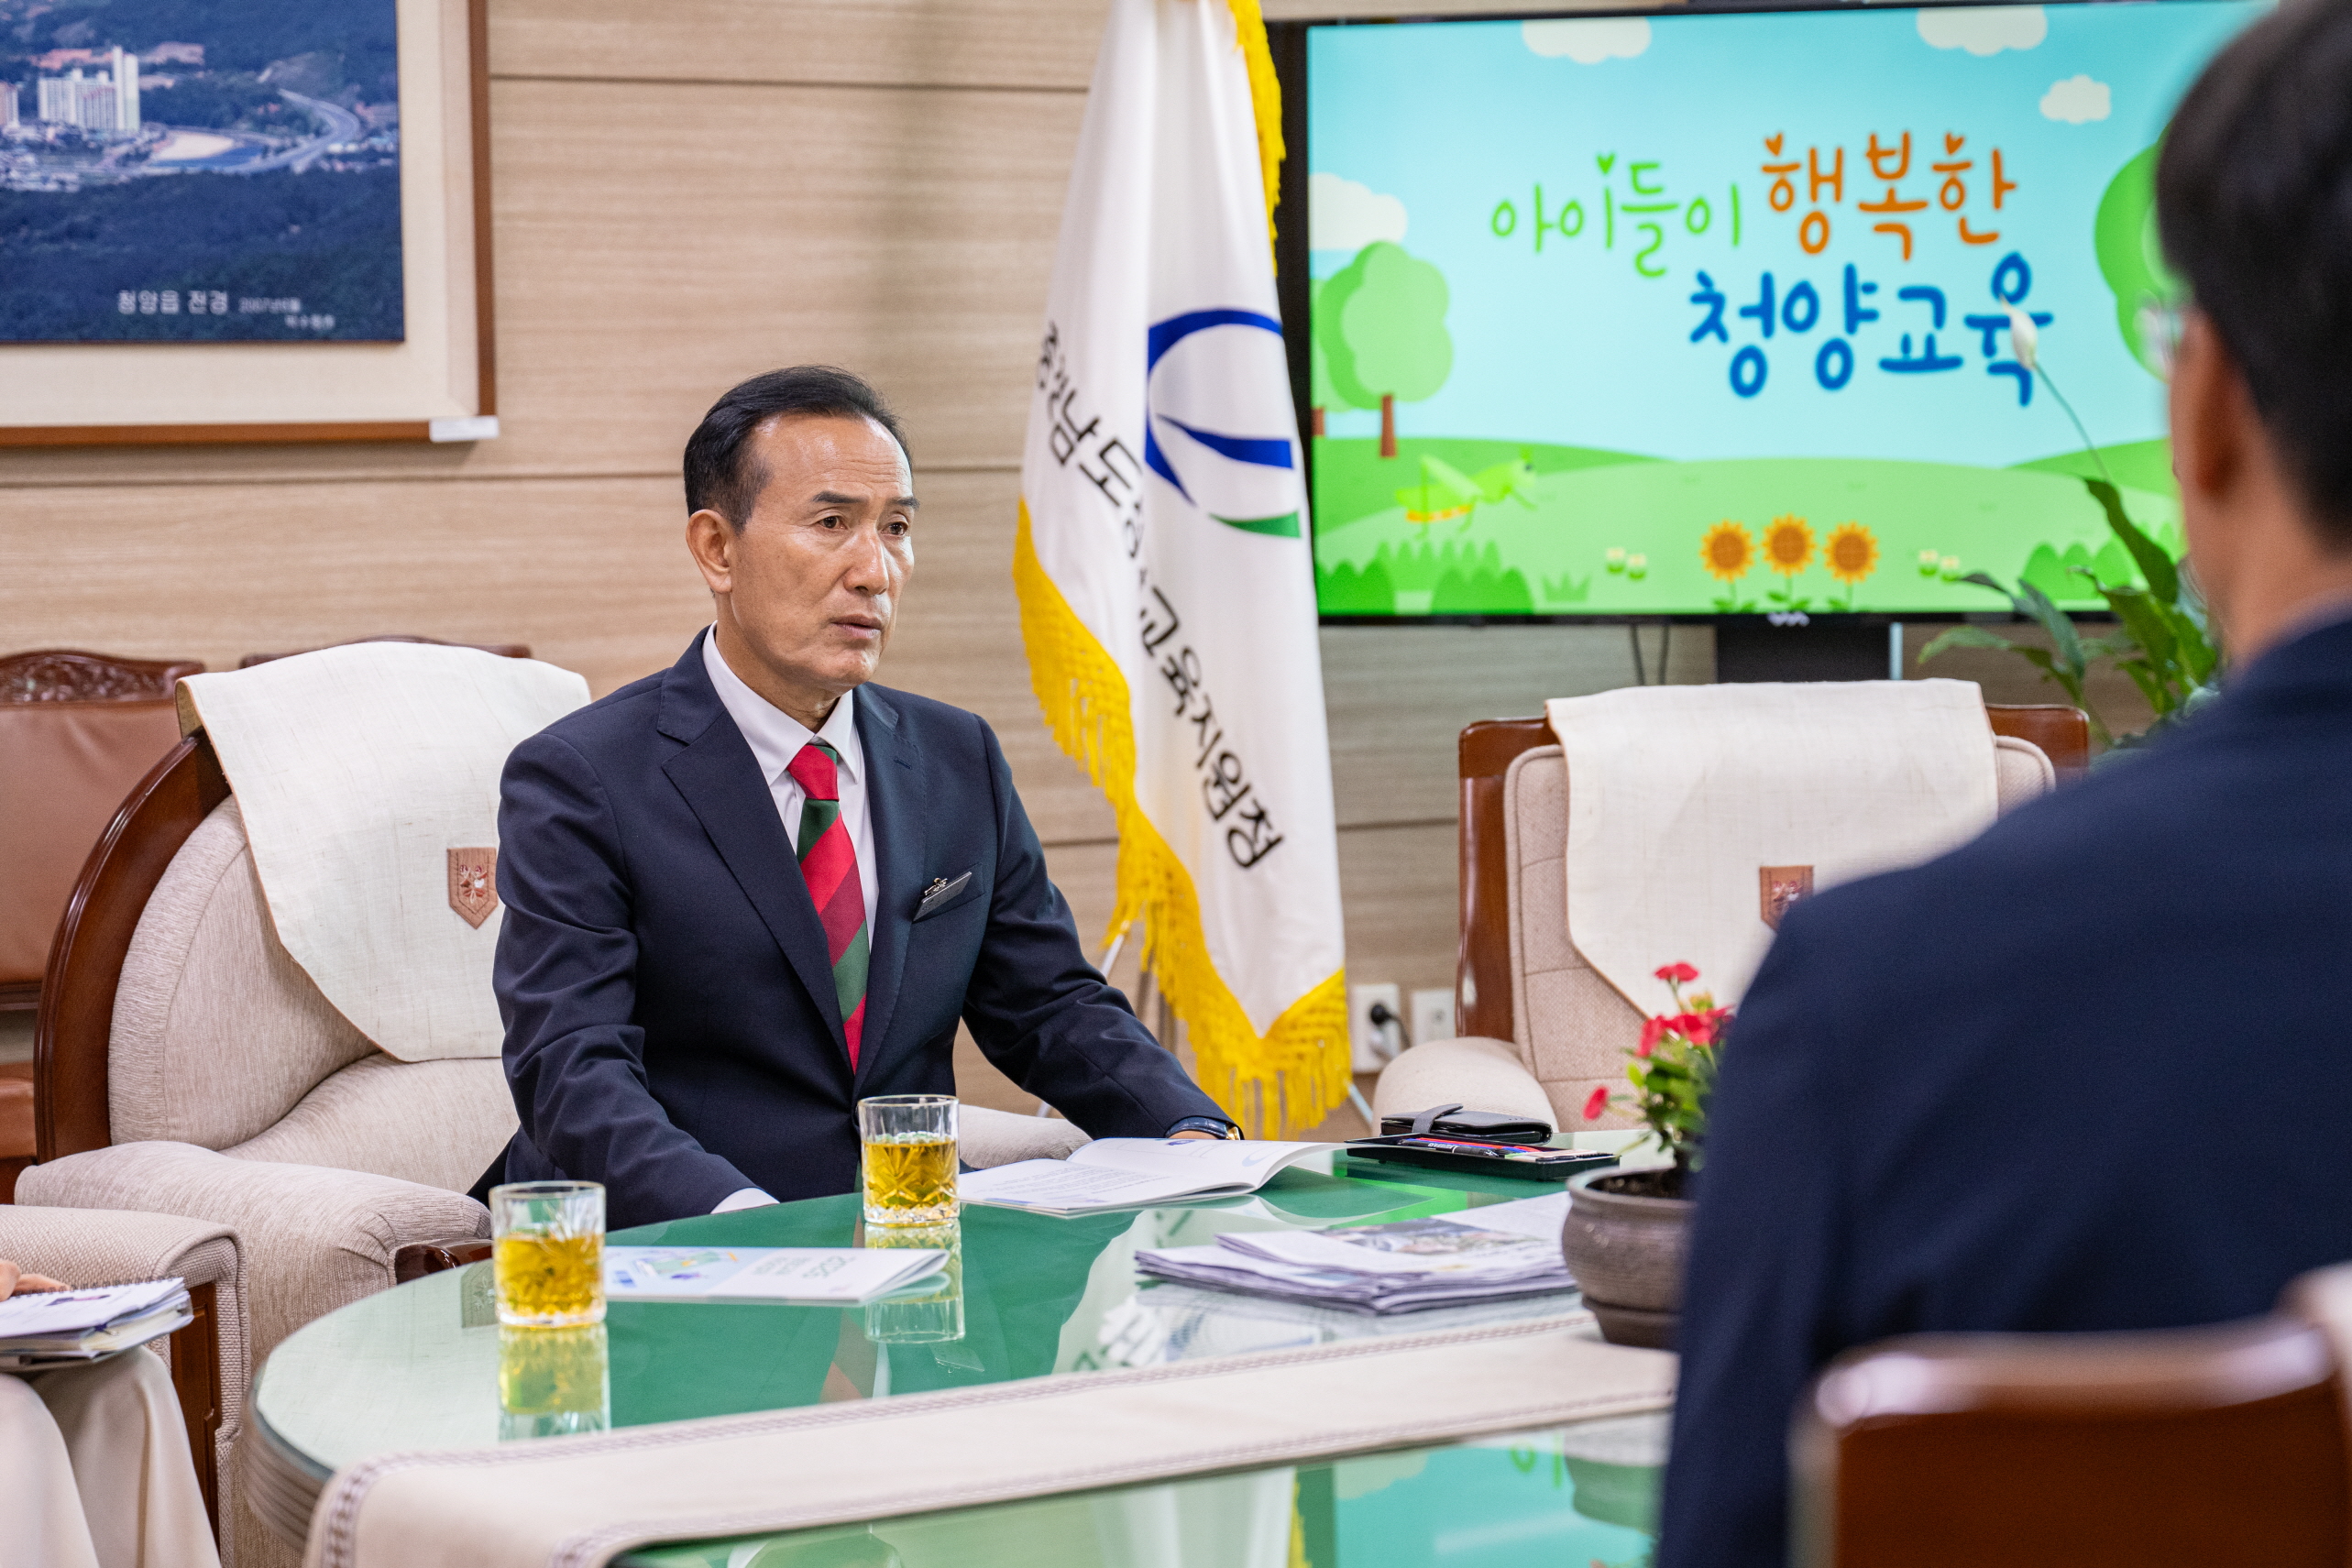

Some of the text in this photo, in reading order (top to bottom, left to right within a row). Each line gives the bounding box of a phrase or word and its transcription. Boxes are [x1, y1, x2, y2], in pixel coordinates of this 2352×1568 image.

[1491, 131, 2018, 278] 아이들이 행복한
[117, 290, 180, 315] 청양읍
[188, 290, 228, 315] 전경
[1689, 252, 2054, 407] 청양교육
